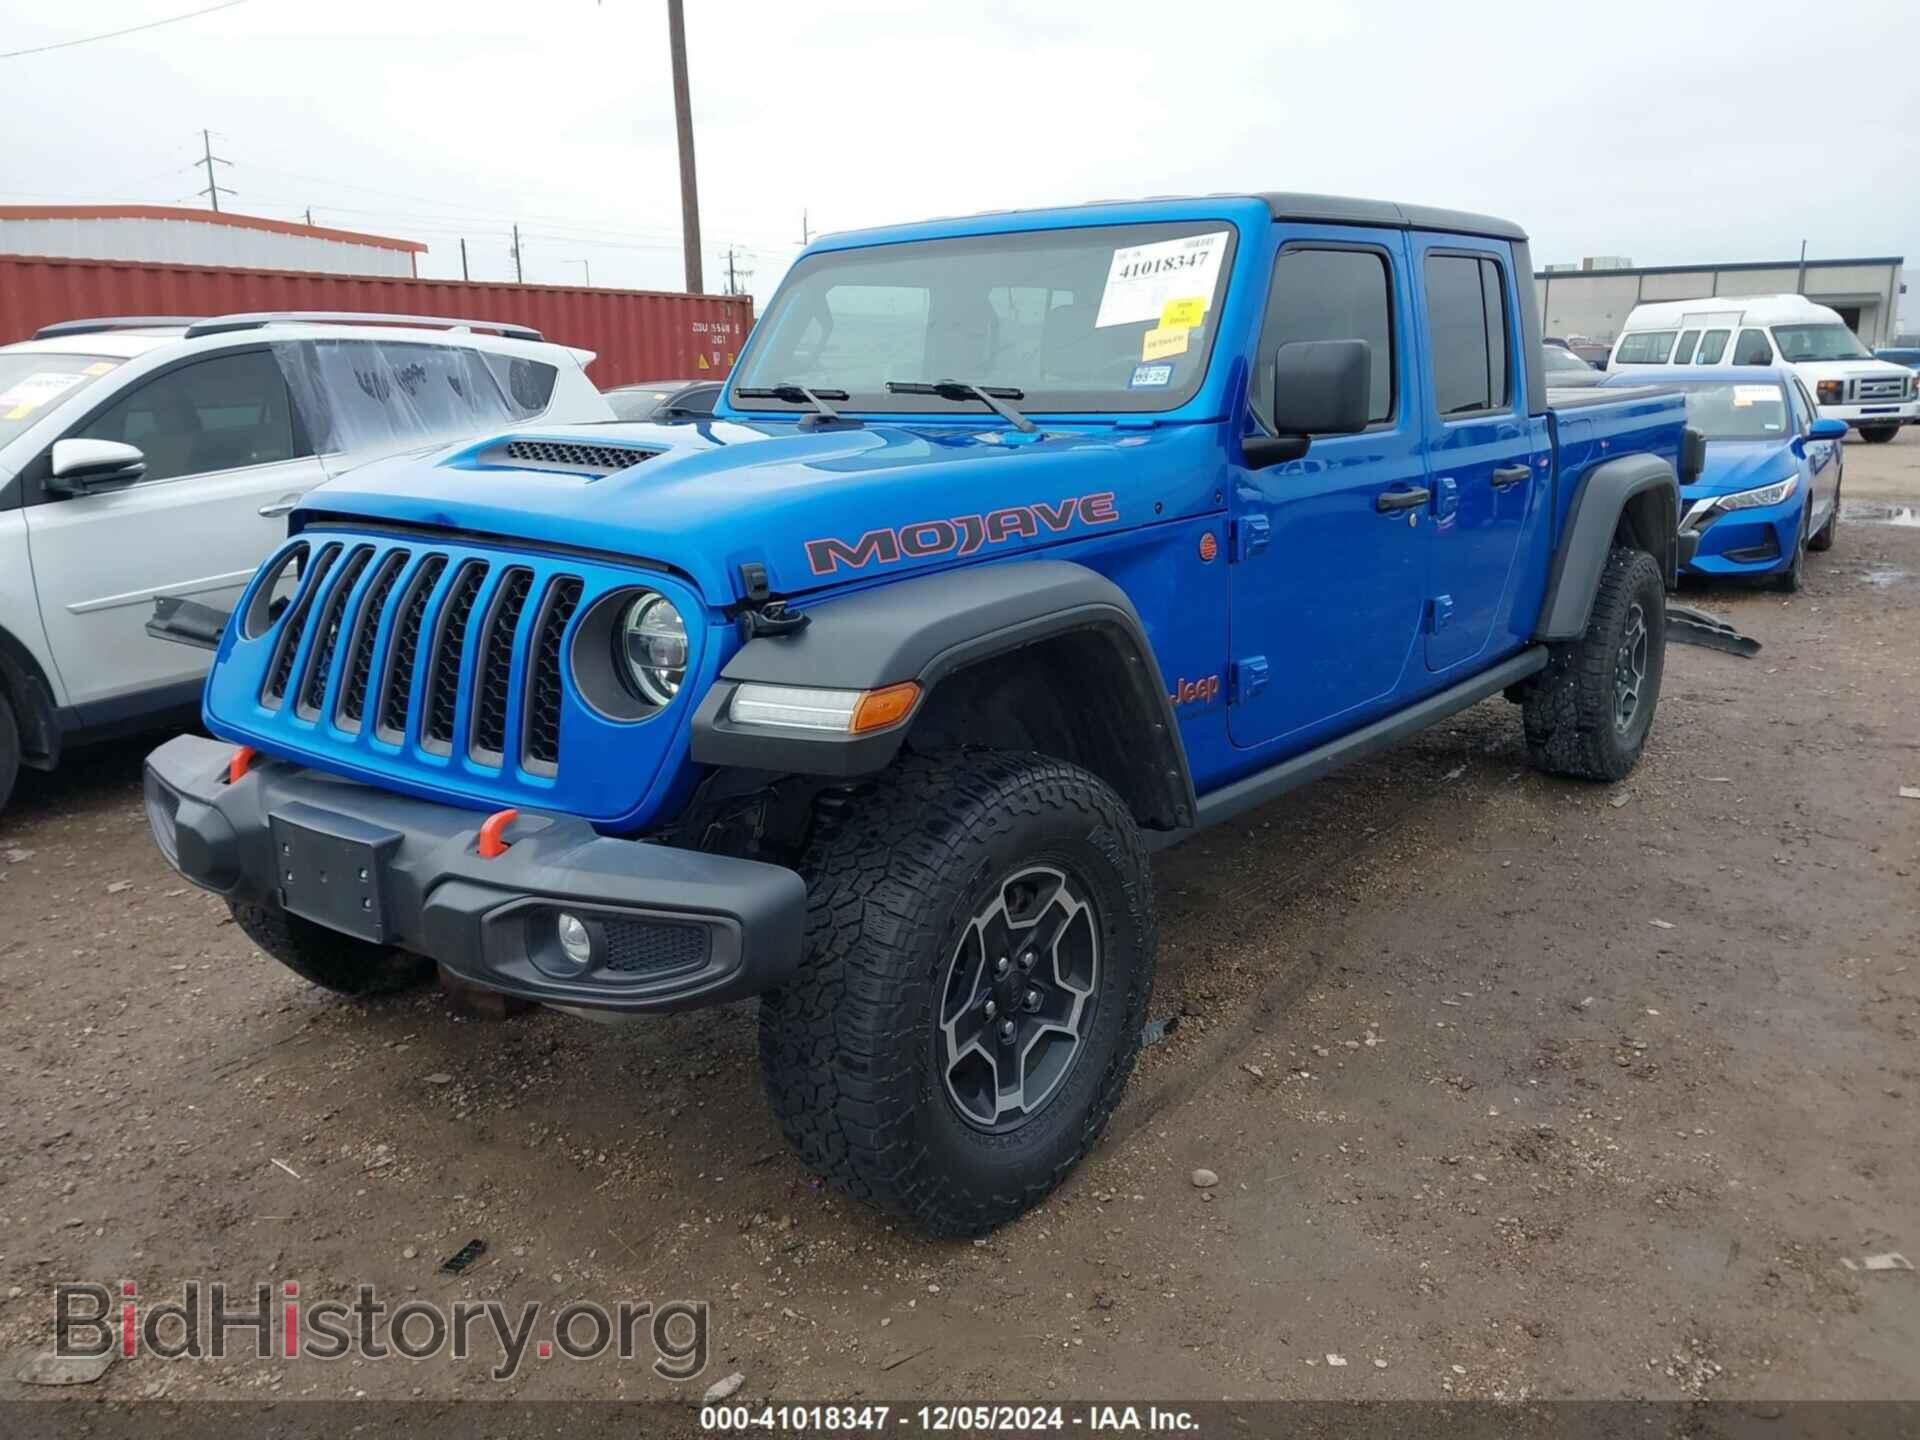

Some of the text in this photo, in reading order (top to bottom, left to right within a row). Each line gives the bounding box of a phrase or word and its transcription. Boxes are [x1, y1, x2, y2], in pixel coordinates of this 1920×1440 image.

[1120, 251, 1209, 278] 41018347
[804, 491, 1120, 575] MOJAVE
[1167, 674, 1219, 704] Jeep
